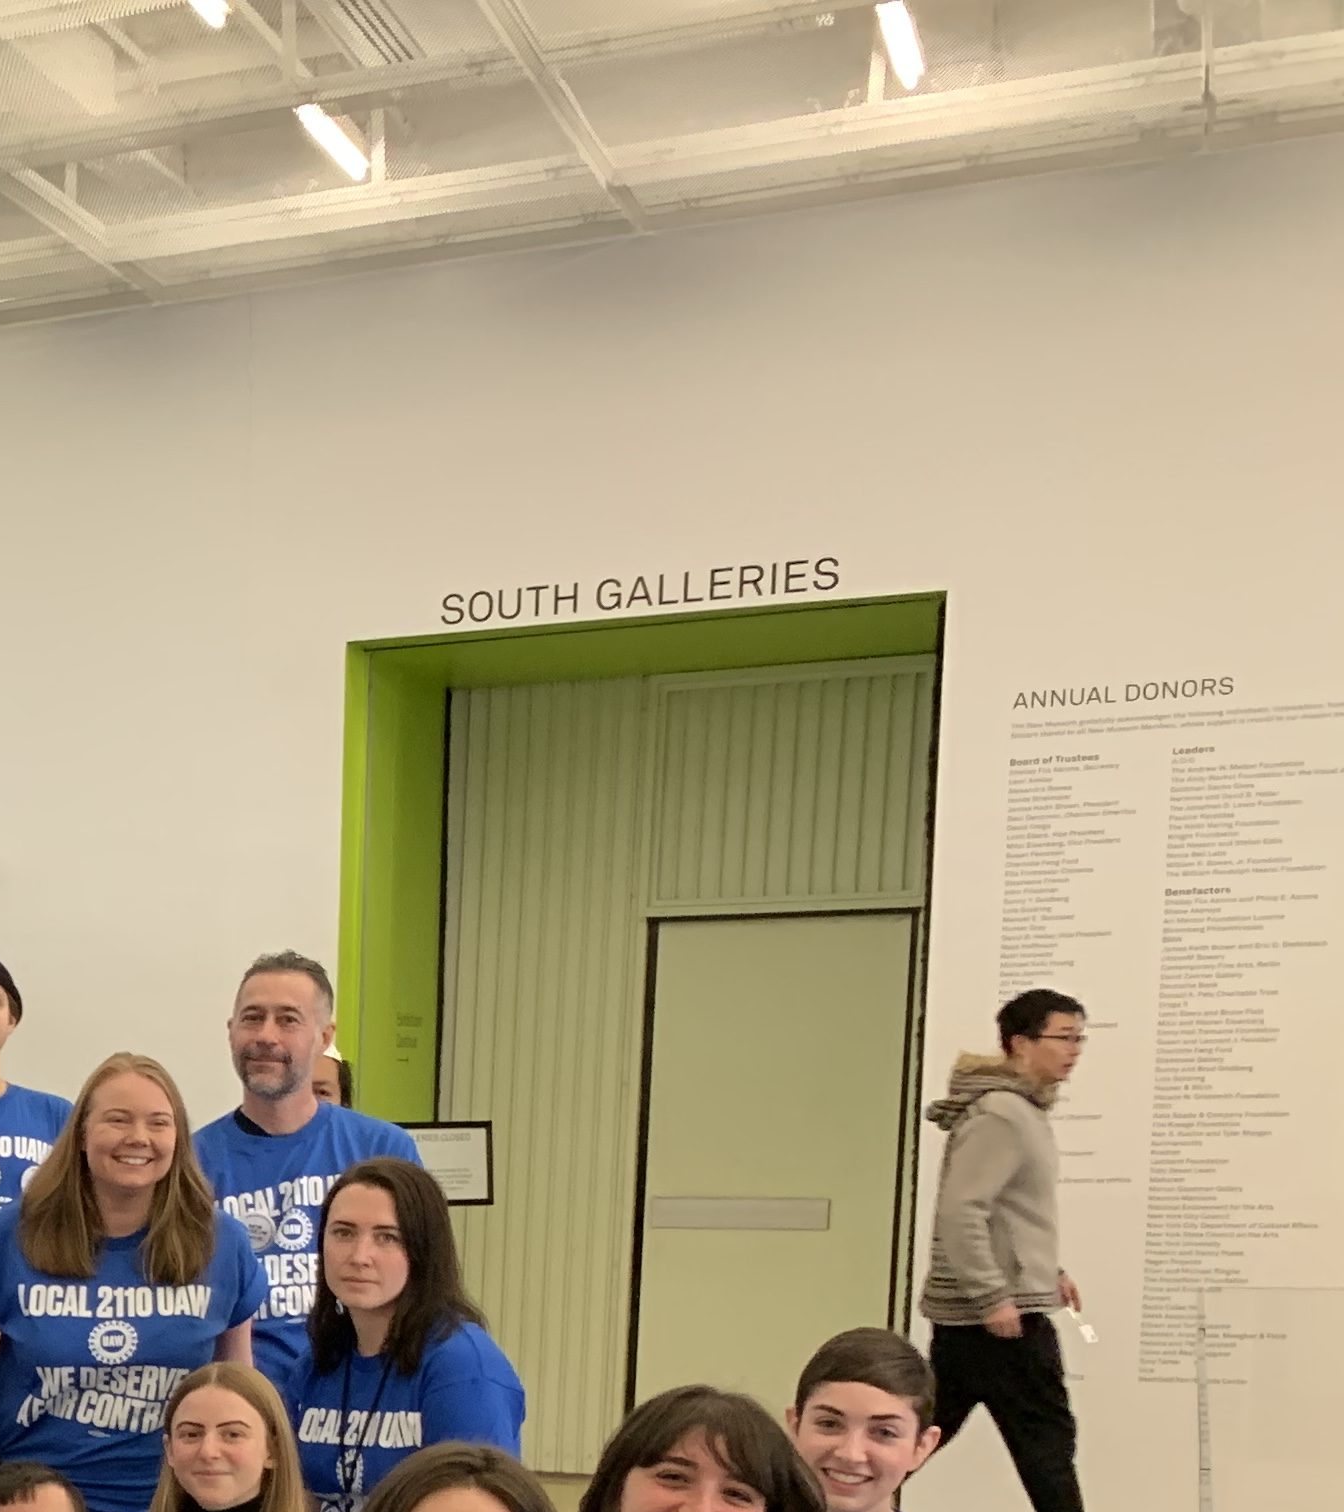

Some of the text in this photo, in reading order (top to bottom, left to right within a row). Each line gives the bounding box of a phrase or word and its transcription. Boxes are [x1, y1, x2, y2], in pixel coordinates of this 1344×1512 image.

[440, 556, 840, 625] SOUTH GALLERIES
[1013, 677, 1234, 709] ANNUAL DONORS
[215, 1176, 324, 1219] OCAL 2110
[264, 1253, 318, 1286] DESE
[18, 1284, 211, 1320] LOCAL 2110 UAW
[36, 1366, 76, 1400] WE
